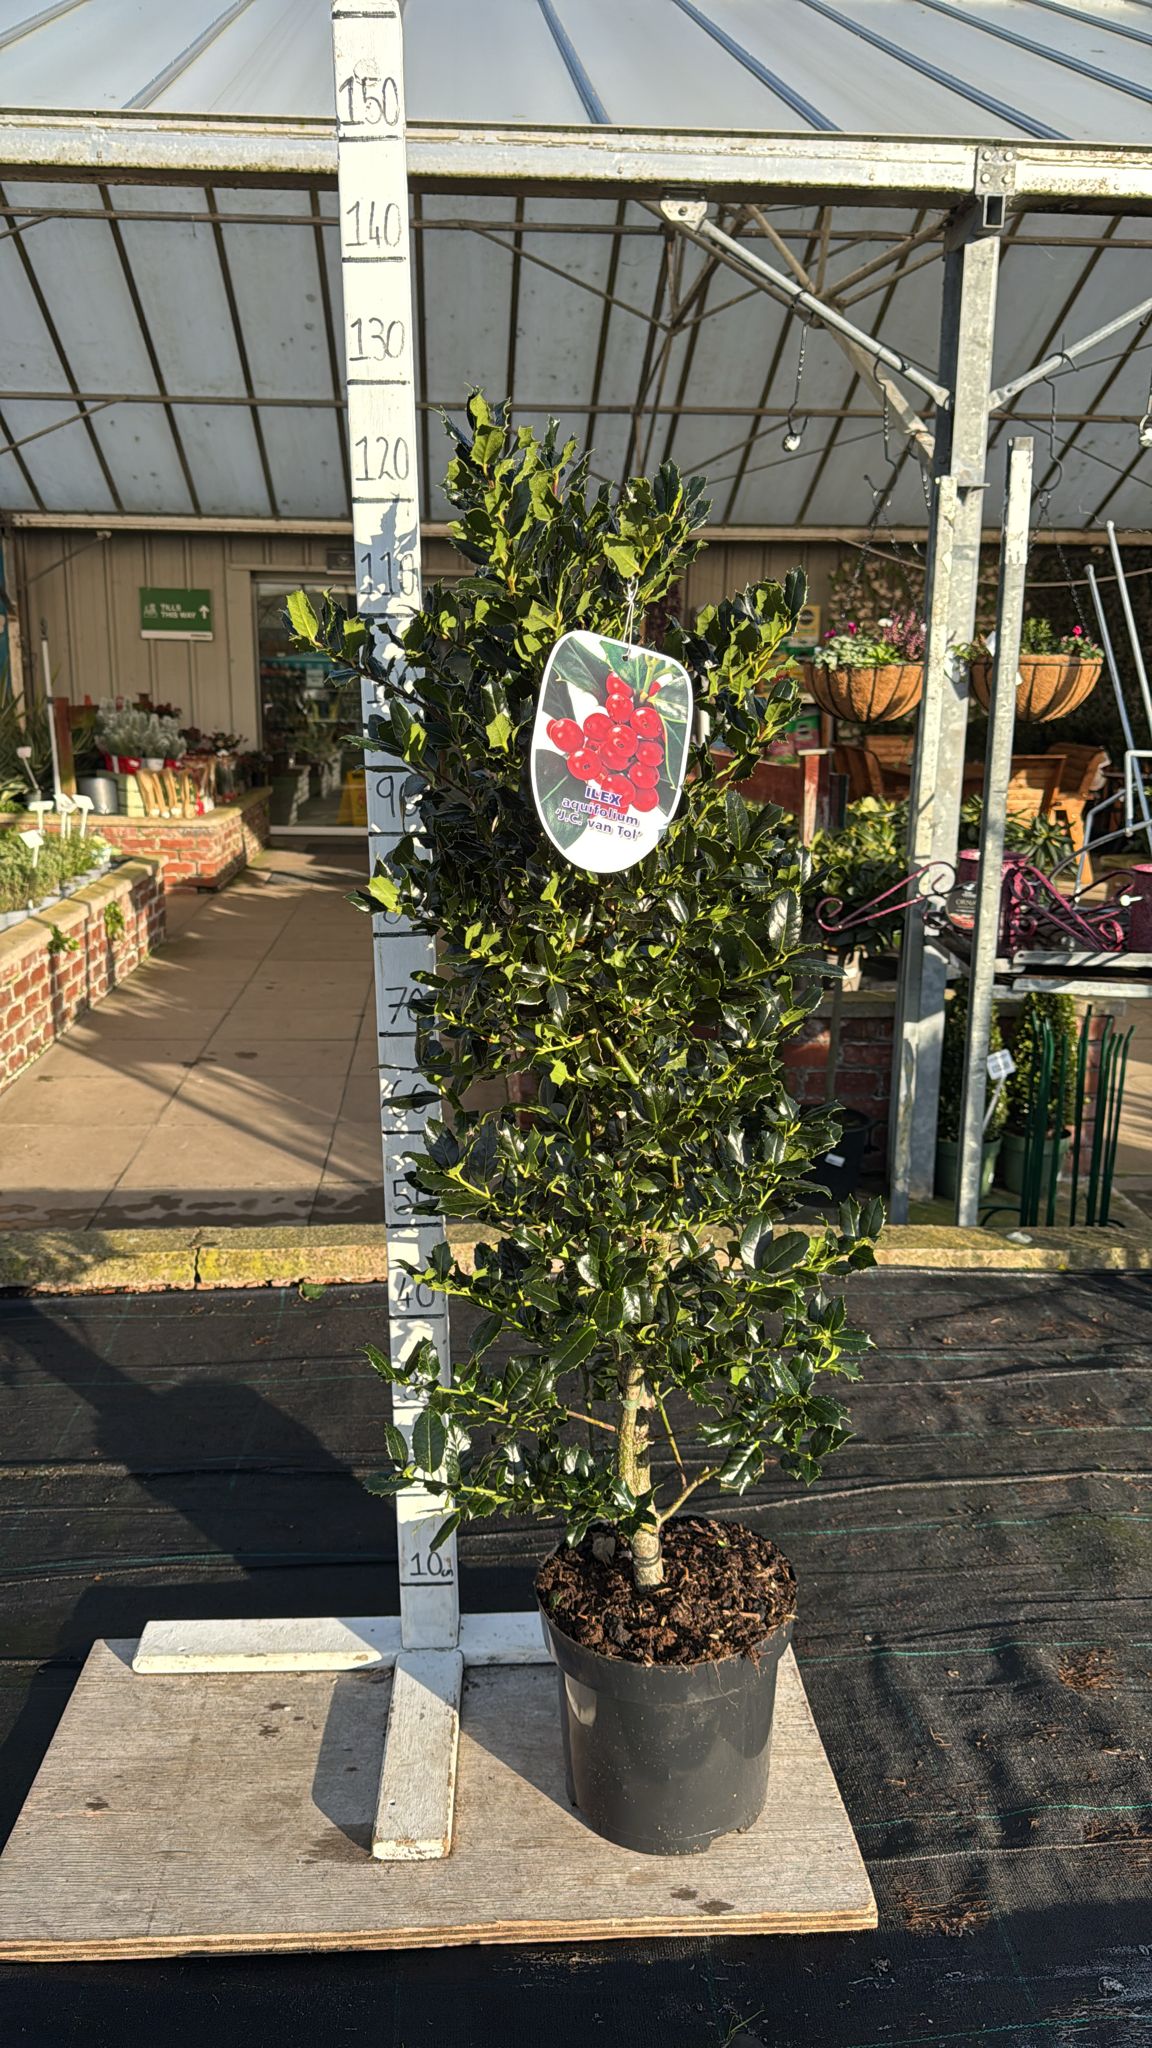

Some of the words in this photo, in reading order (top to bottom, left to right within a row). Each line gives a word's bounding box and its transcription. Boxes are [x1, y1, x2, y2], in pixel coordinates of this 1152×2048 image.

[339, 76, 400, 126] 150
[345, 201, 401, 248] 140
[349, 317, 404, 361] 130
[355, 436, 409, 481] 120
[360, 552, 414, 596] 110
[562, 799, 639, 826] aquifolium
[586, 787, 621, 806] ILEX
[588, 818, 613, 833] van
[397, 1277, 436, 1308] 40
